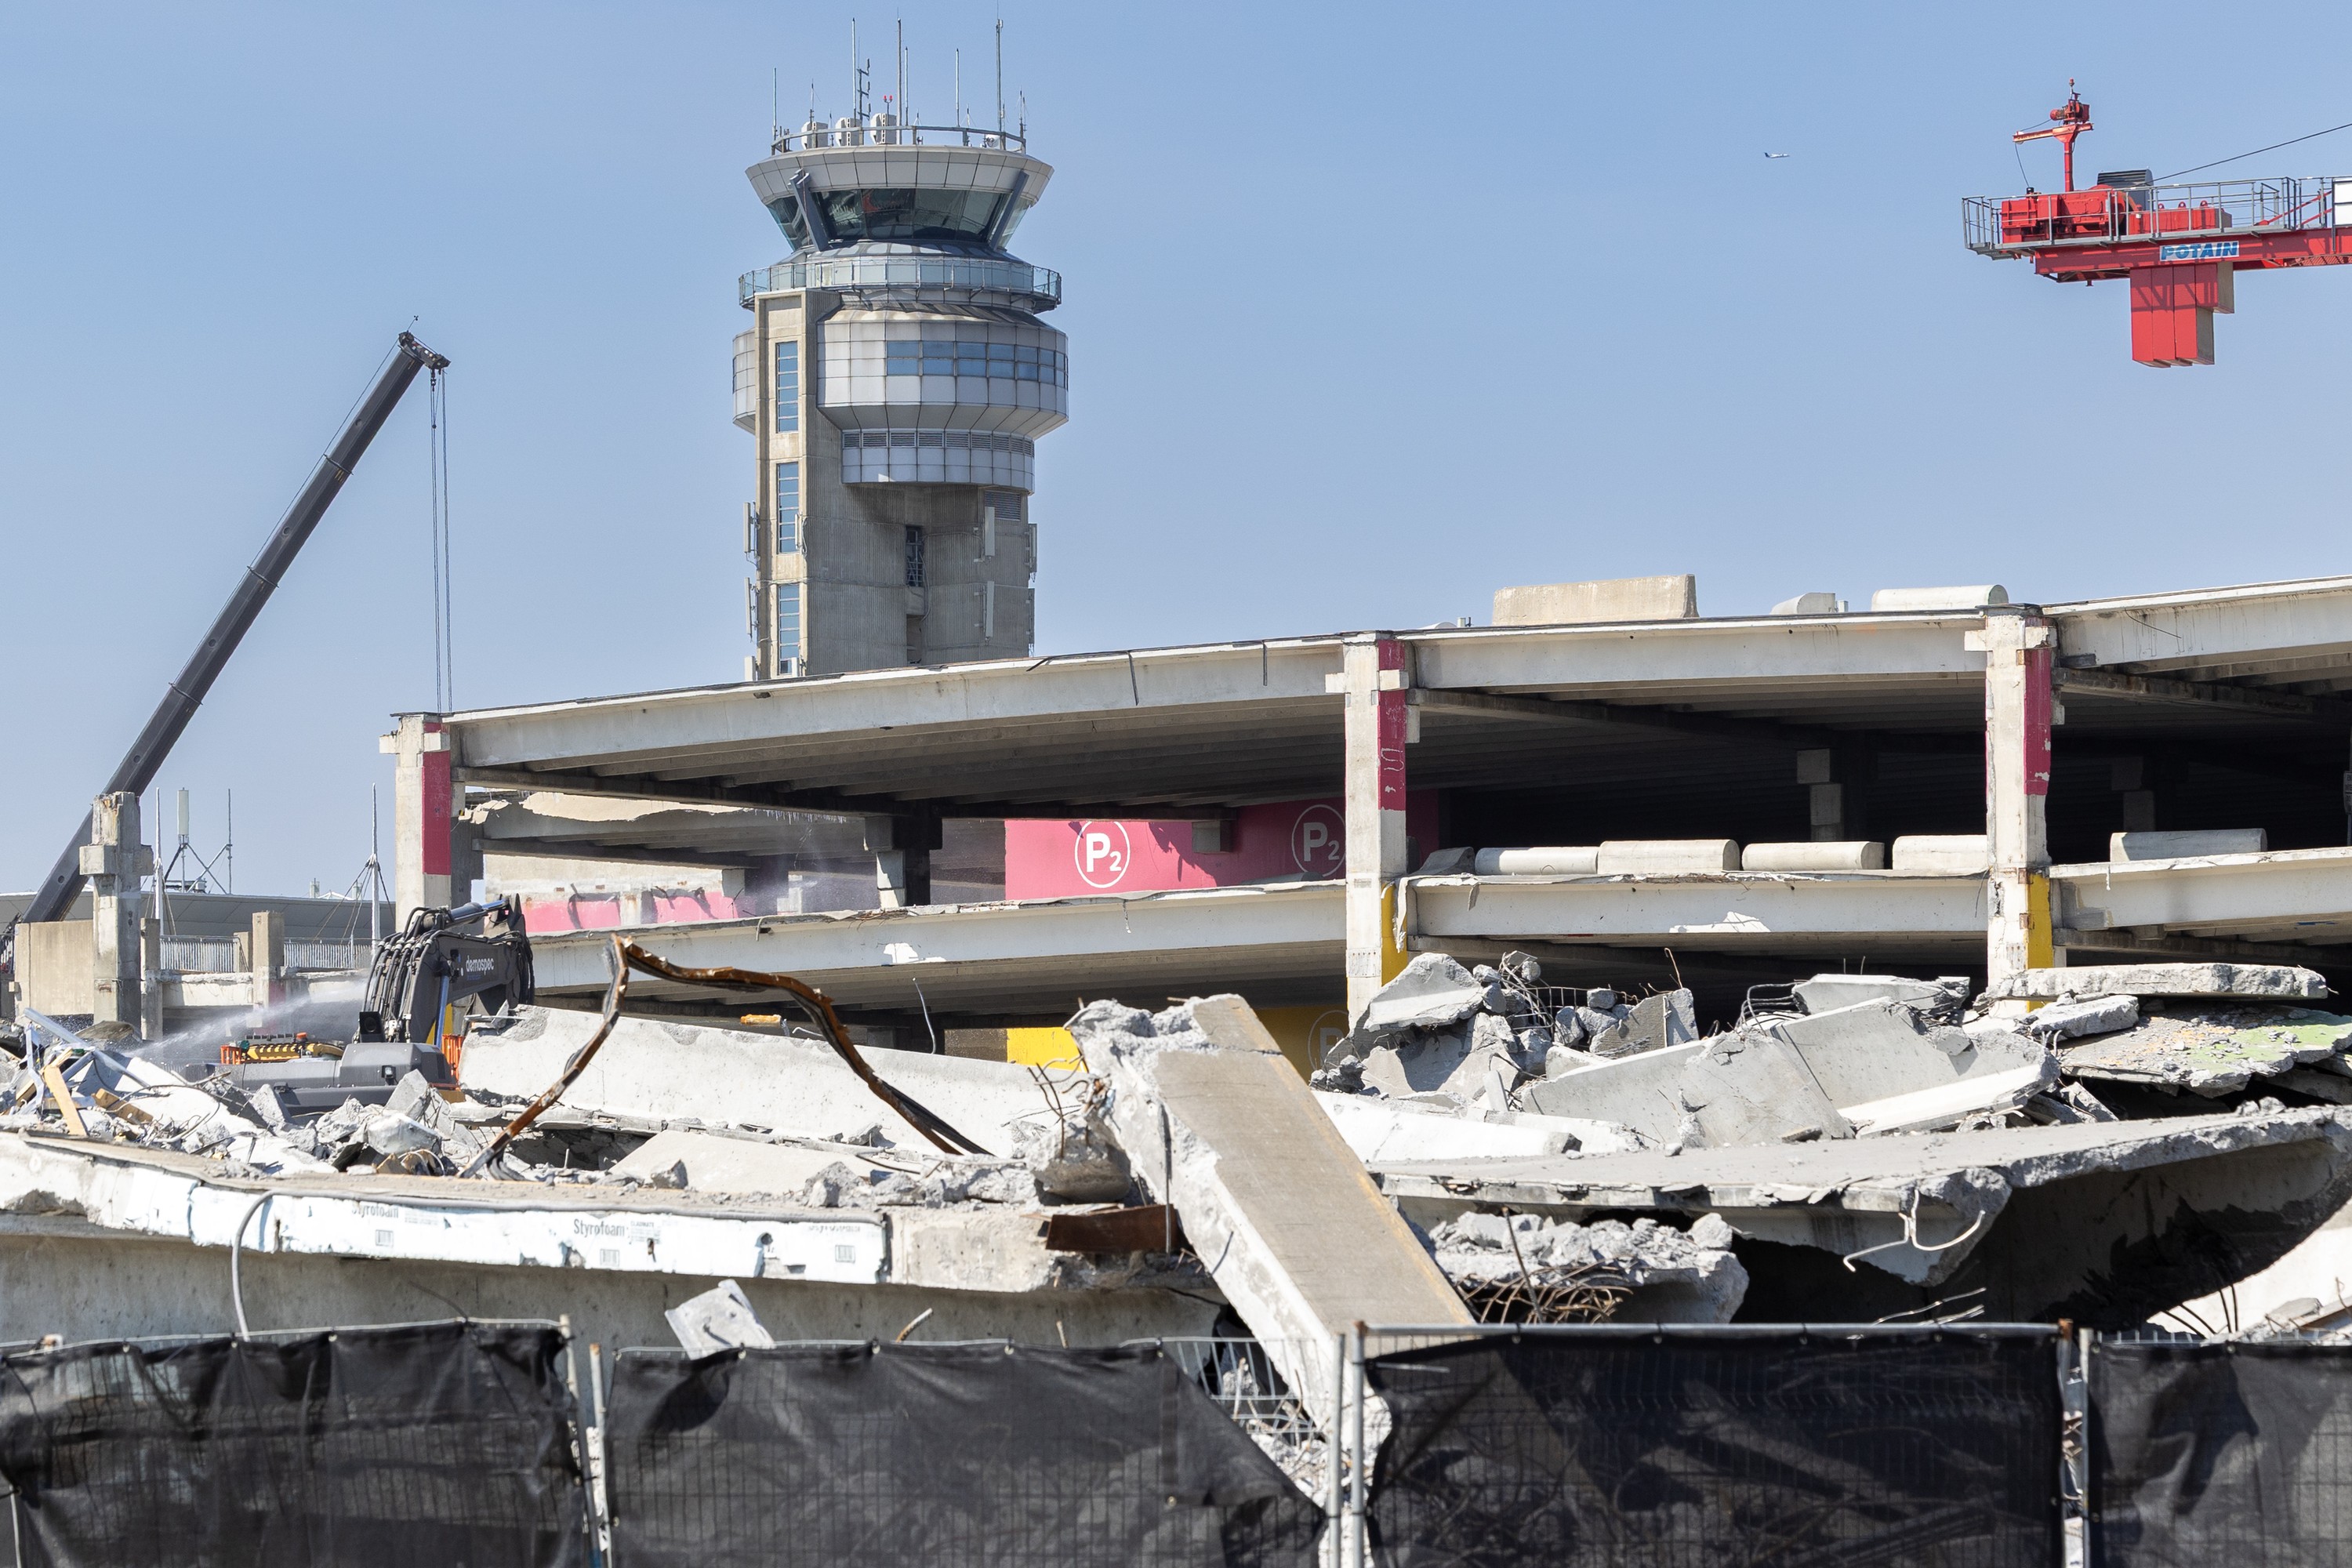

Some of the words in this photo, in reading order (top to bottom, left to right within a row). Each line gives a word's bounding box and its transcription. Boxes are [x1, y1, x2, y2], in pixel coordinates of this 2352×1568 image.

[2161, 241, 2238, 260] POTAIN
[1303, 822, 1340, 862] P2
[1086, 833, 1122, 873] P2
[466, 955, 495, 976] demospec
[573, 1218, 625, 1238] Styrofoam
